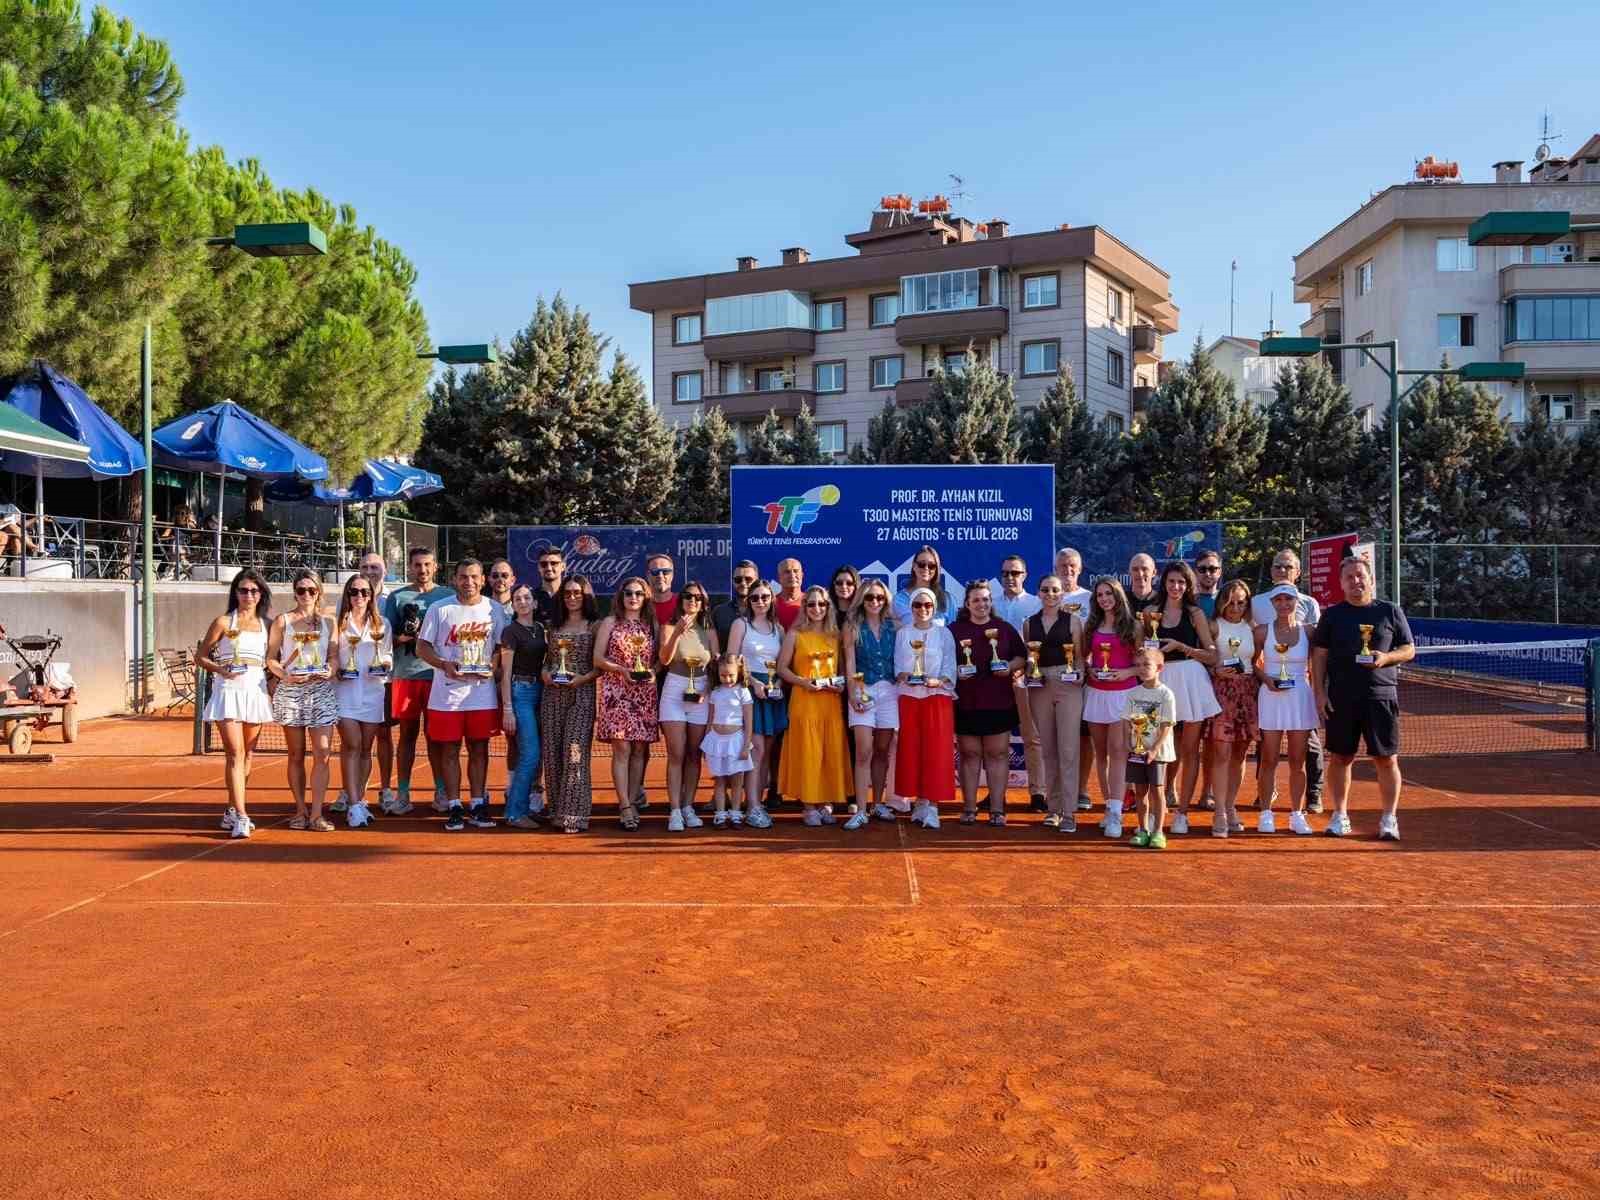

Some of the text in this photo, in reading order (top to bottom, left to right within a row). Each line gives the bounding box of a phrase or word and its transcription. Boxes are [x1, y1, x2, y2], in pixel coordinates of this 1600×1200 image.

[891, 489, 1004, 503] PROF. DR. AYHAN KIZIL
[863, 506, 1033, 522] T300 MASTERS TENİS TURNUVASI
[792, 536, 842, 545] FEDERASYONU
[876, 527, 890, 541] 27
[892, 526, 940, 541] AĞUSTOS
[947, 527, 955, 541] 6
[957, 525, 989, 541] EYLÜL
[991, 527, 1018, 541] 2026
[677, 539, 713, 556] PROF.
